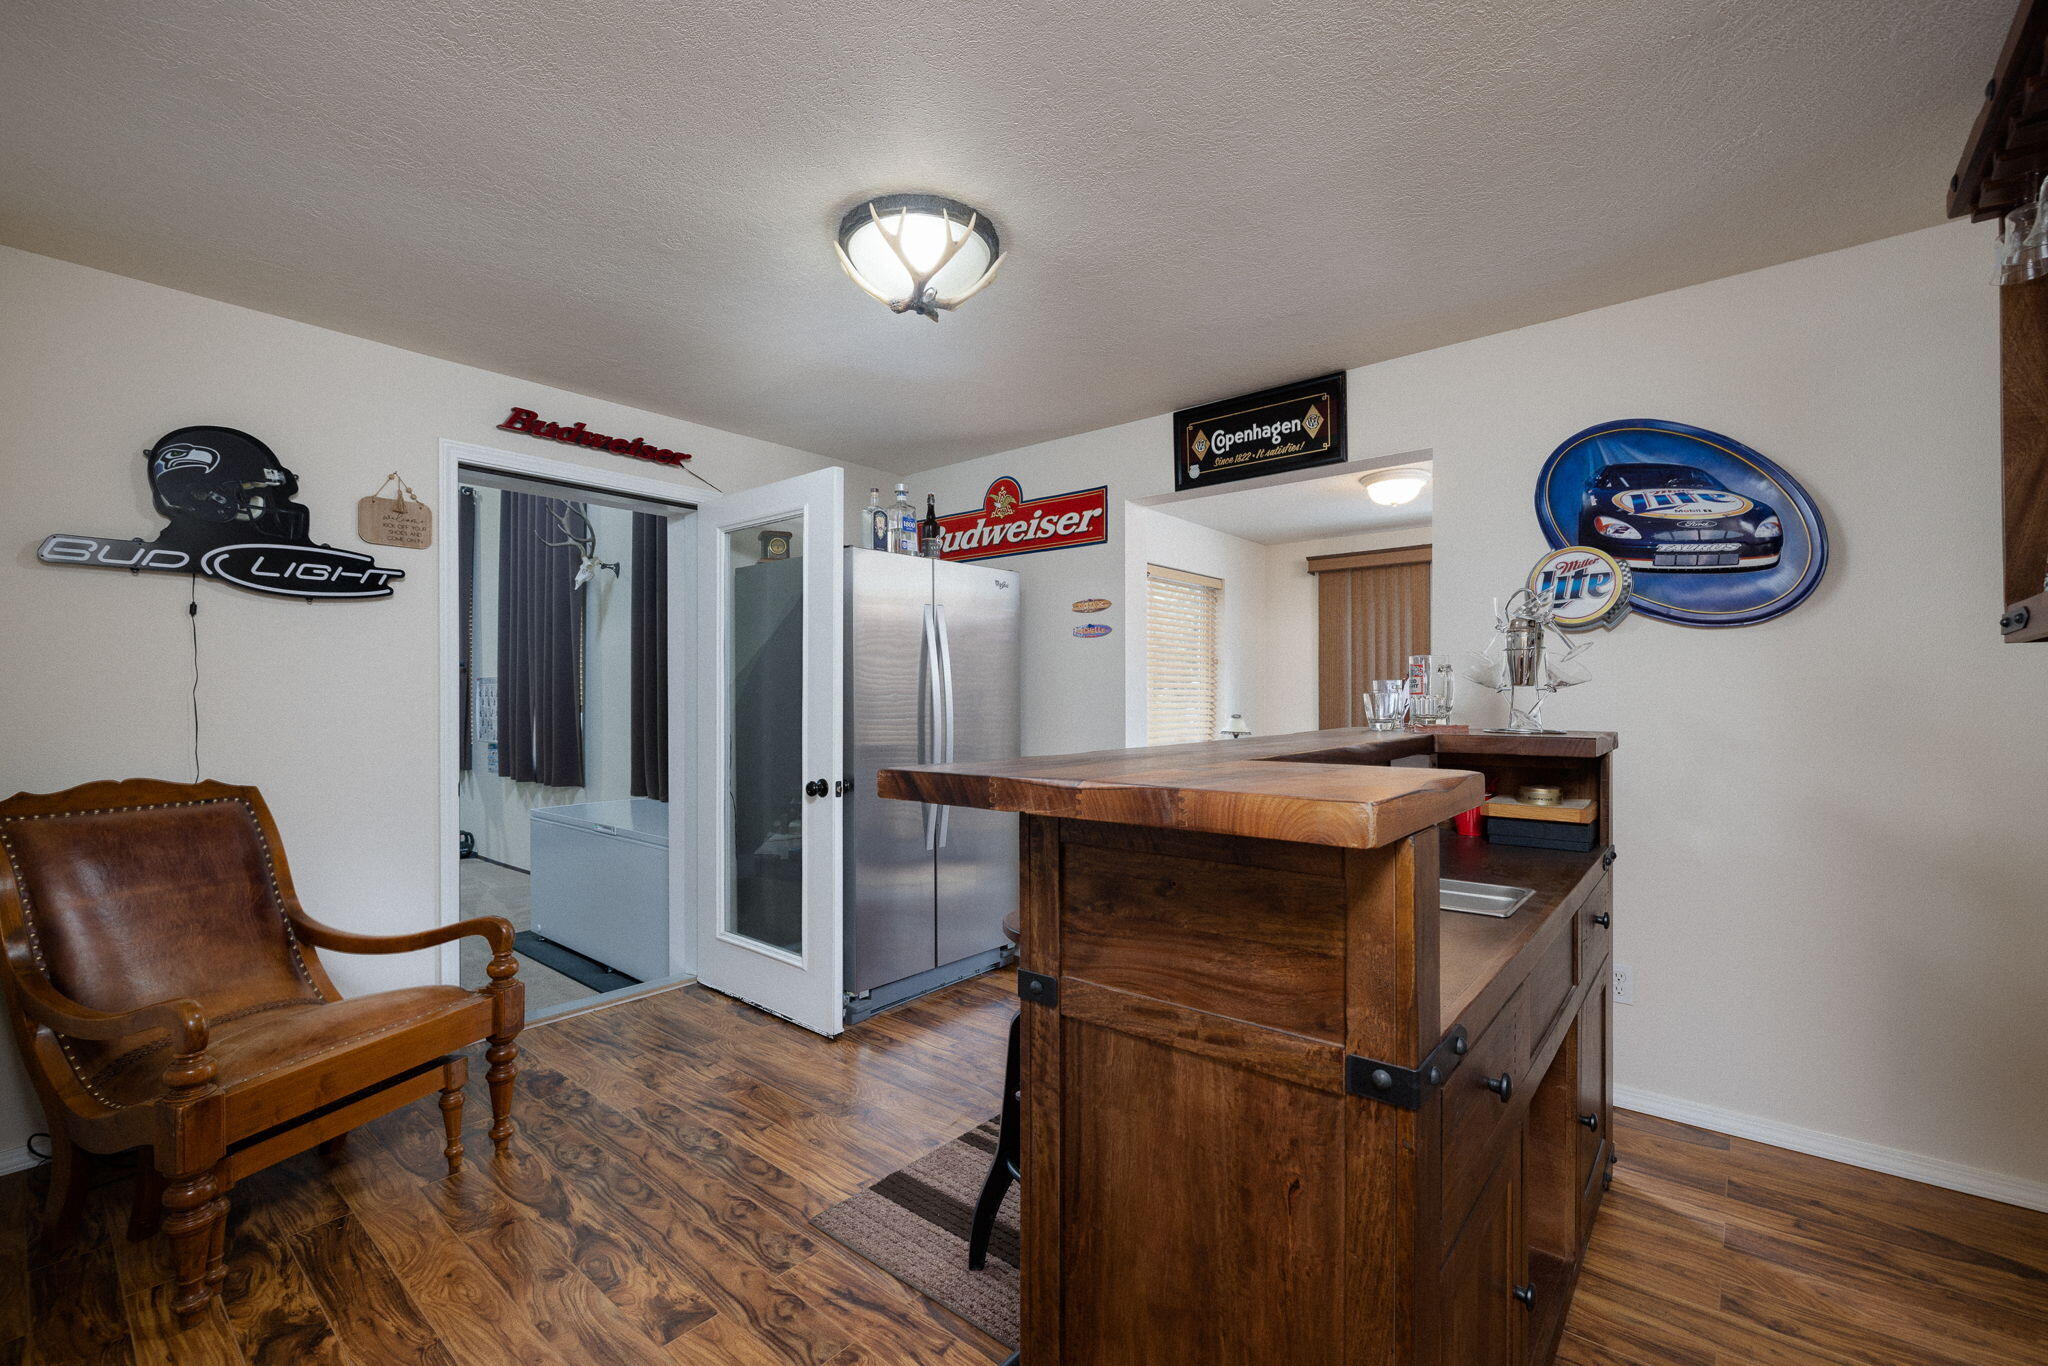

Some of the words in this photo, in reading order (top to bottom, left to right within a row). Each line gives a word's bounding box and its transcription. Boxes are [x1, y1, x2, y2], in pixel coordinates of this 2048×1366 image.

[496, 407, 692, 467] Budweiser
[1211, 419, 1301, 455] Copenhagen
[1213, 456, 1235, 467] Since
[1234, 452, 1252, 463] 1822
[1630, 492, 1736, 514] Lite
[1685, 520, 1710, 528] Ford
[42, 537, 191, 568] BUD
[1656, 543, 1742, 552] TAURUS
[250, 556, 405, 585] LIGHT
[1556, 557, 1601, 575] Miller
[1536, 568, 1613, 609] Lite
